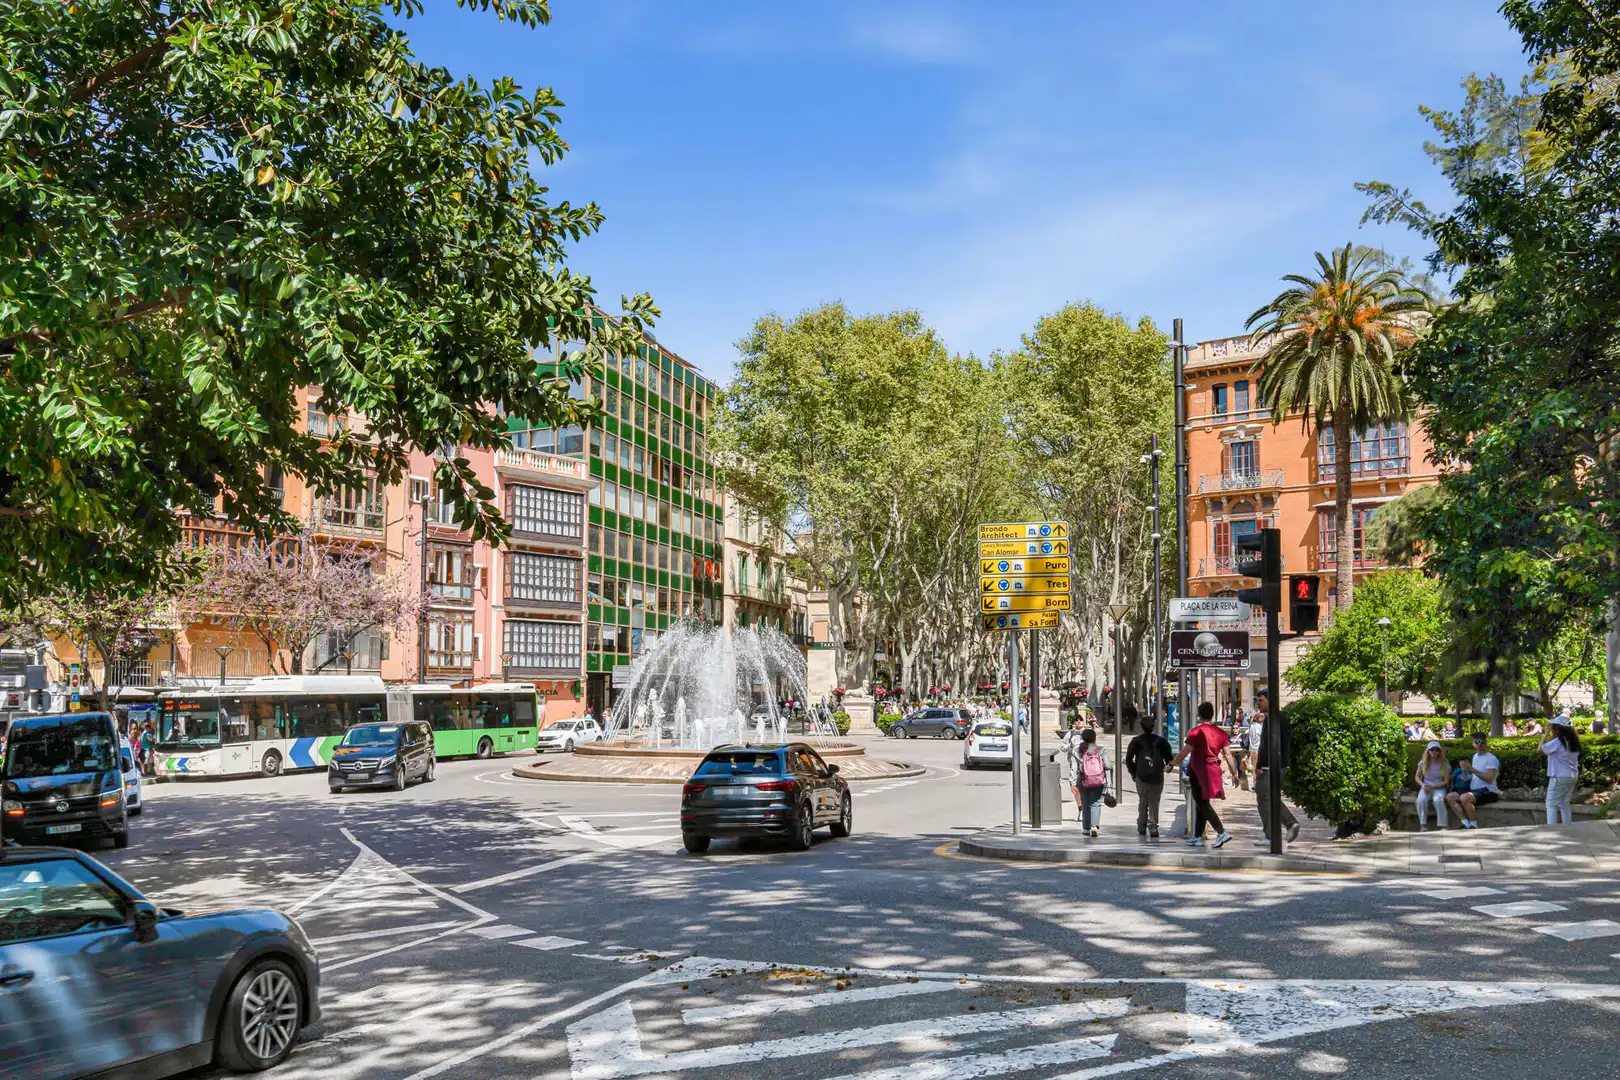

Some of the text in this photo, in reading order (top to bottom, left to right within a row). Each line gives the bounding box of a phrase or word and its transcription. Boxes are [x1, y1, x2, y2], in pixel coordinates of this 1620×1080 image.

[1045, 561, 1067, 569] Puro
[1046, 580, 1067, 588] Tres
[1181, 602, 1239, 612] PLAÇA DE LA REINA
